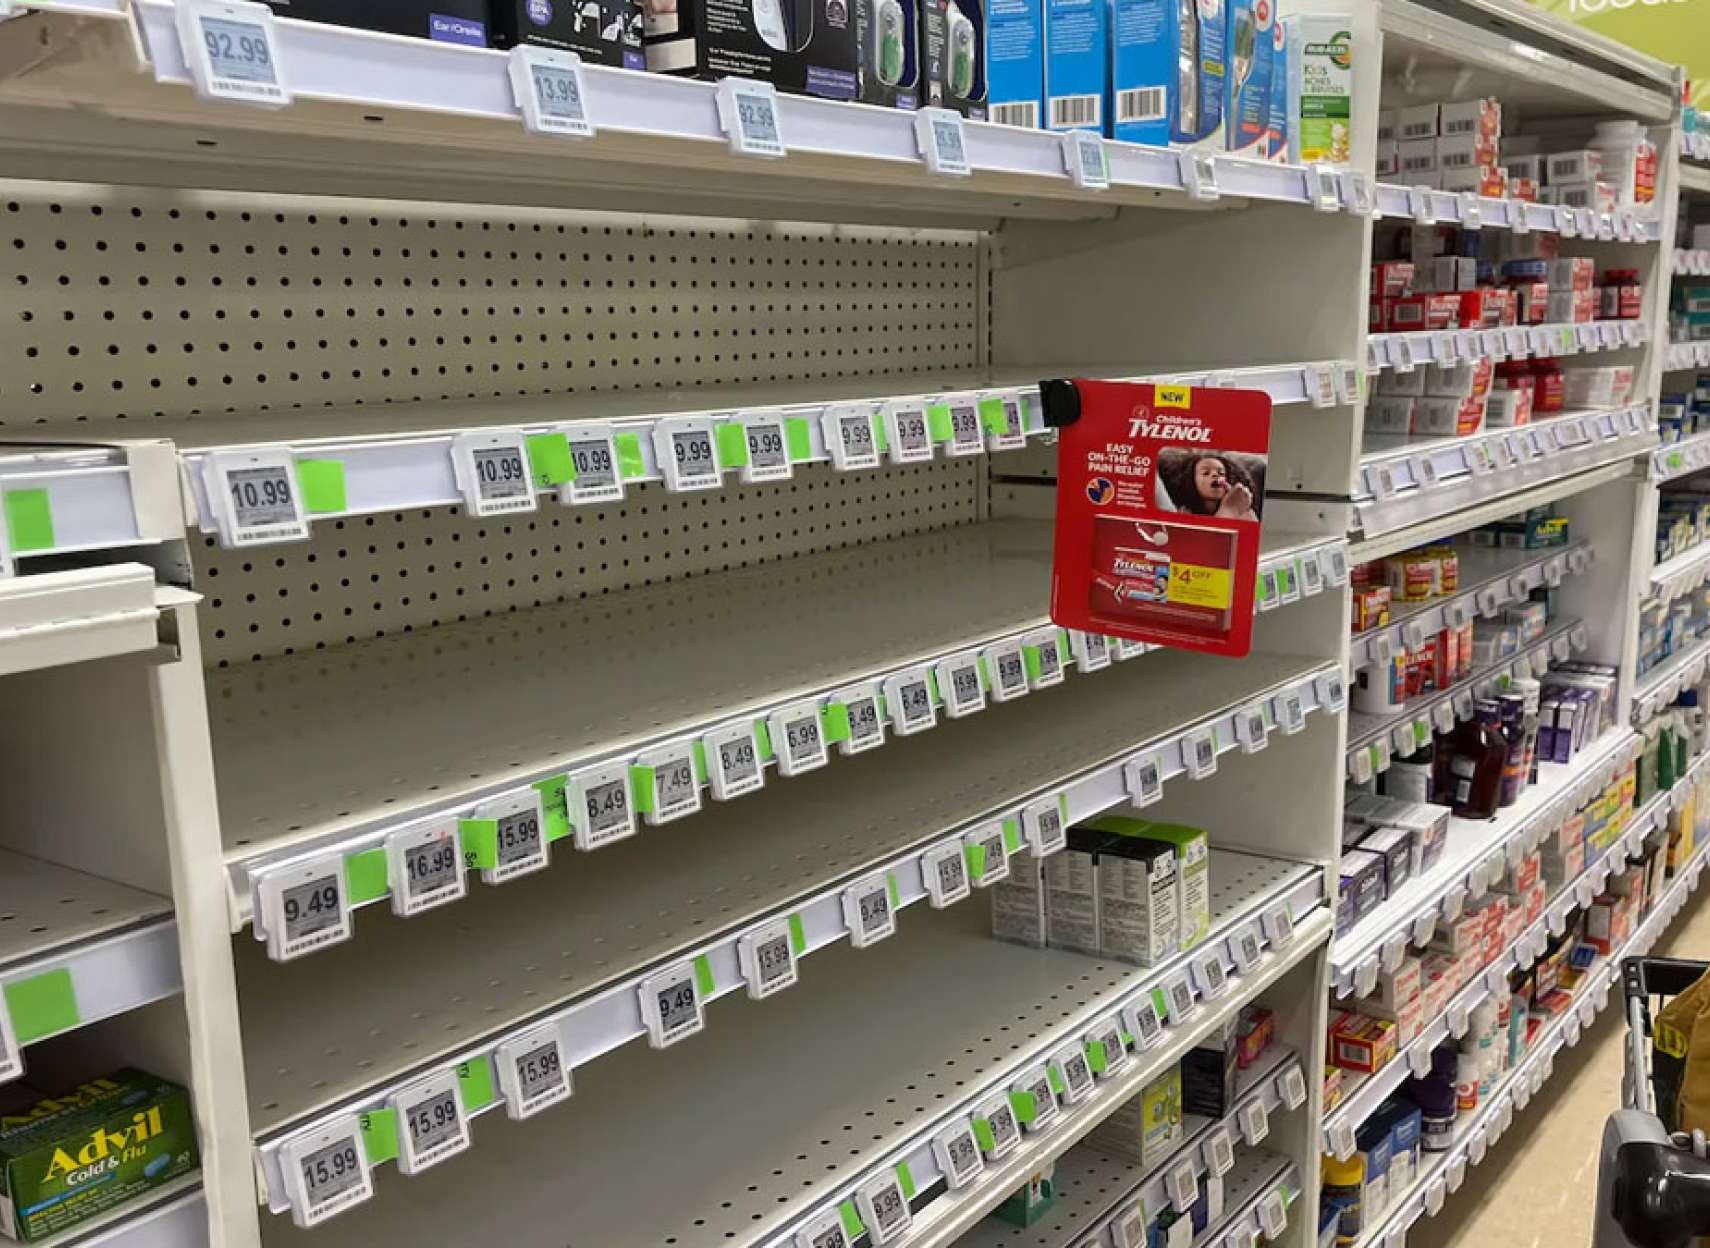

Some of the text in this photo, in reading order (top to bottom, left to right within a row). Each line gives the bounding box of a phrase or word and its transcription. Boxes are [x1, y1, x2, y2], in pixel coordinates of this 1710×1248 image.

[206, 30, 269, 66] 92.99
[535, 76, 579, 103] 13.99
[1161, 391, 1184, 403] NEW
[1128, 418, 1214, 442] TYLENOL
[1156, 415, 1202, 426] Children's
[675, 441, 712, 462] 9.99
[750, 434, 782, 454] 9.99
[1107, 443, 1134, 453] EASY
[476, 457, 522, 482] 10.99
[1088, 451, 1151, 467] ON-THE-GO
[1088, 463, 1149, 476] PAIN RELIEF
[231, 479, 291, 508] 10.99
[788, 724, 818, 748] 6.99
[721, 745, 753, 770] 8.49
[655, 766, 691, 794] 7.49
[586, 789, 625, 818] 8.49
[497, 819, 538, 848] 15.99
[407, 847, 455, 881] 16.99
[284, 886, 338, 923] 9.49
[660, 988, 694, 1018] 9.49
[518, 1052, 559, 1084] 15.99
[409, 1101, 455, 1138] 15.99
[41, 1105, 163, 1184] Advil
[67, 1145, 146, 1186] Cold & Flu
[304, 1148, 357, 1188] 15.99
